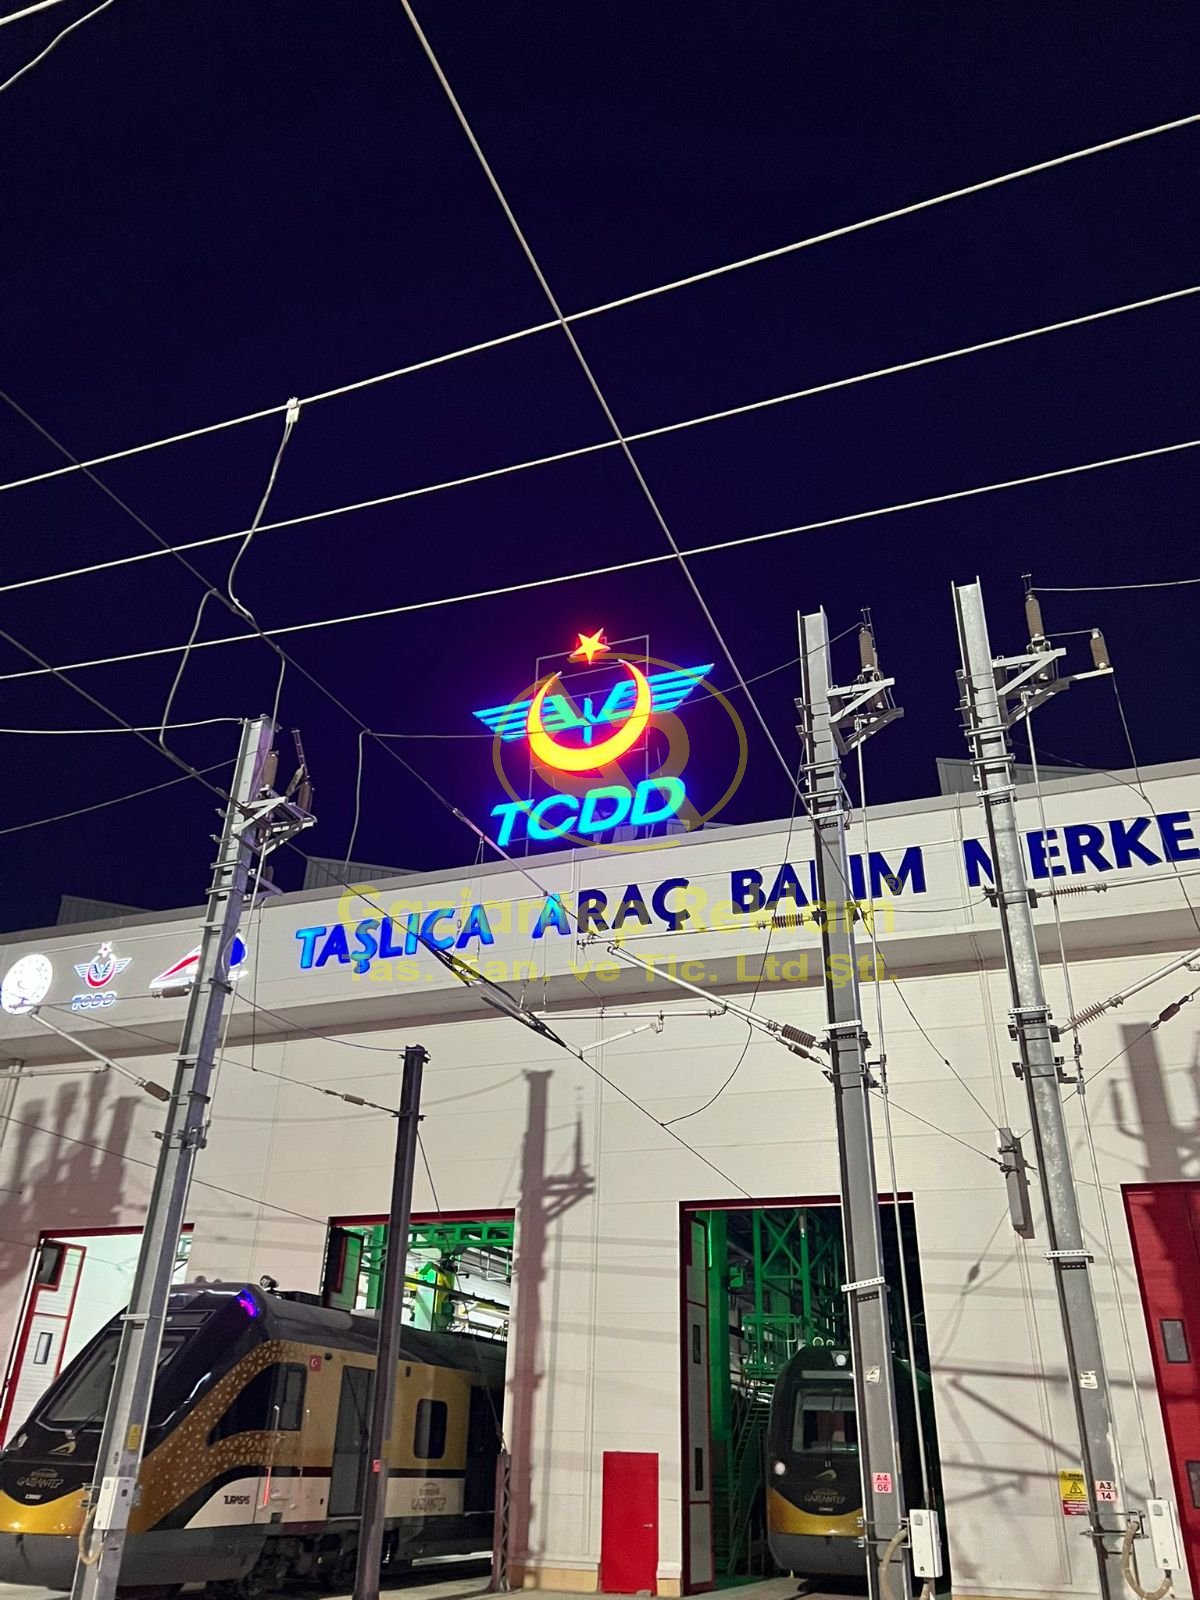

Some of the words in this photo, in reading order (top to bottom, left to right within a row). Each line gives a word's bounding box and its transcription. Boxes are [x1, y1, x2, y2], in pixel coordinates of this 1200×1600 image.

[489, 776, 687, 848] TCDD
[295, 903, 495, 974] TAŞLICA
[531, 877, 691, 939] ARAÇ
[730, 845, 928, 915] BAIM
[72, 991, 117, 1011] TCDD
[877, 1484, 889, 1492] 06
[1099, 1482, 1112, 1490] A3
